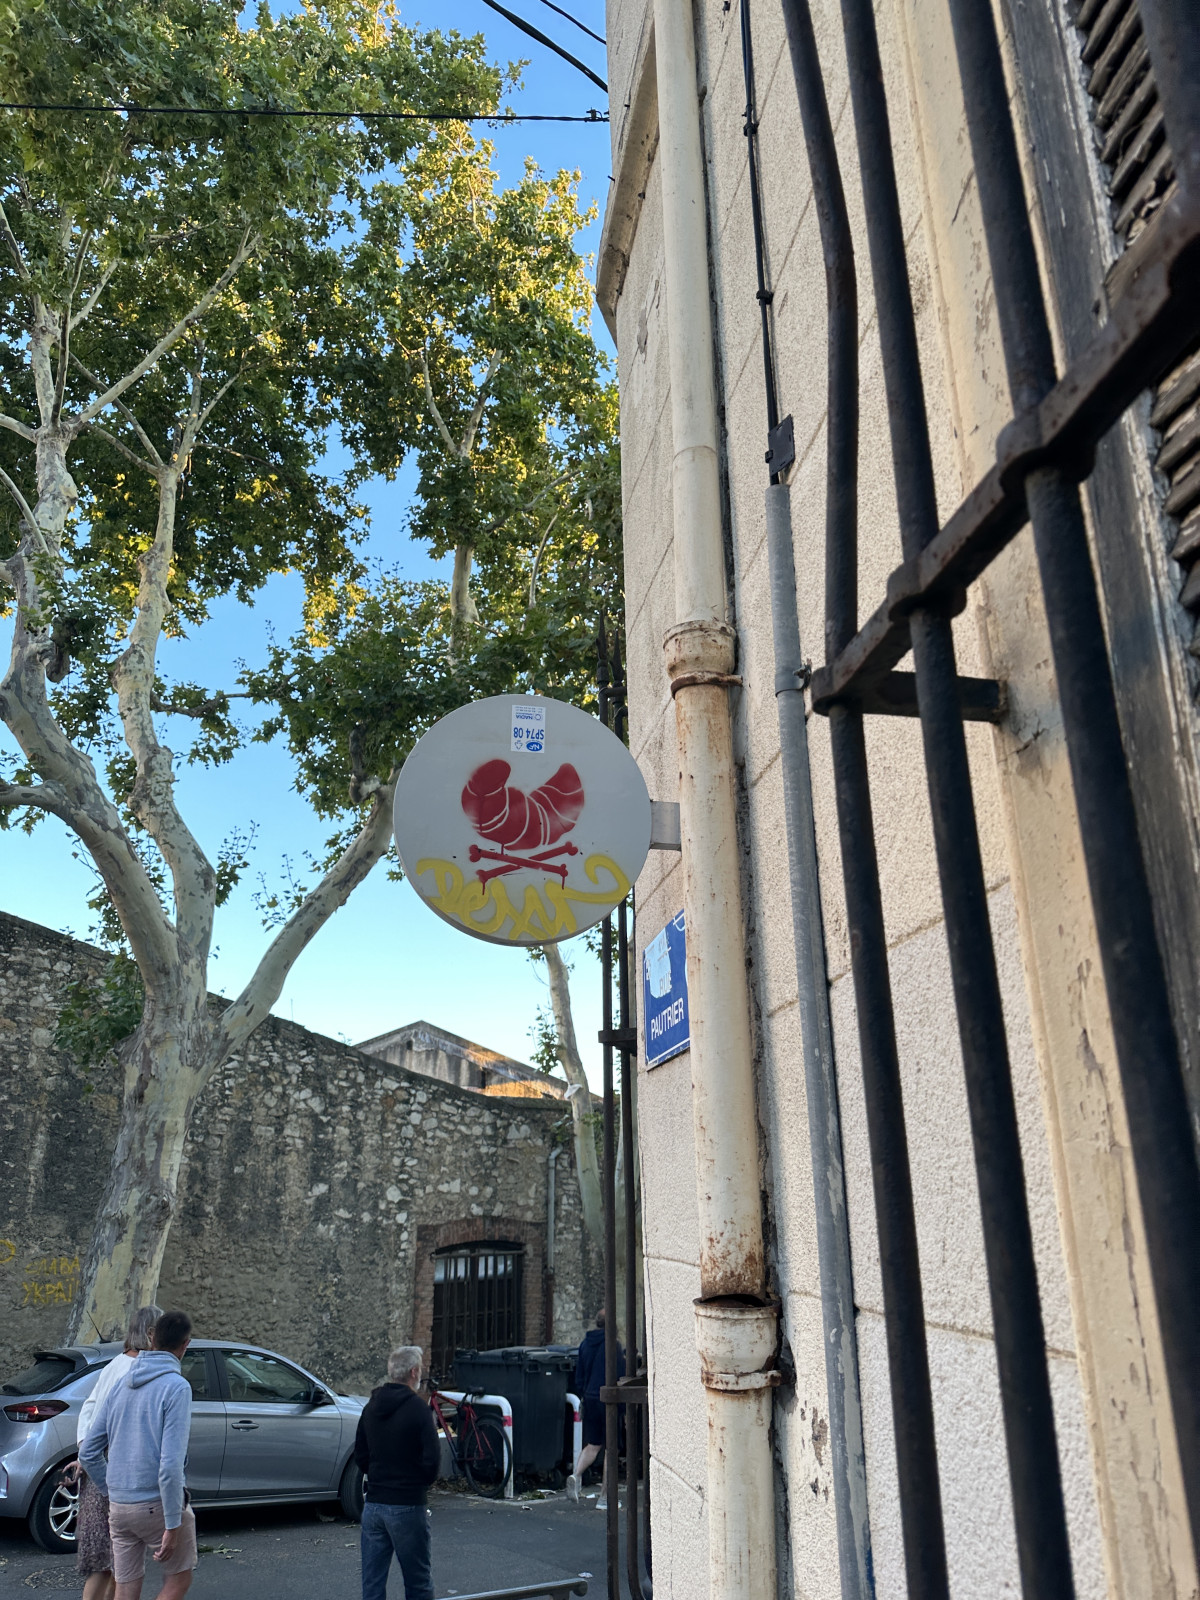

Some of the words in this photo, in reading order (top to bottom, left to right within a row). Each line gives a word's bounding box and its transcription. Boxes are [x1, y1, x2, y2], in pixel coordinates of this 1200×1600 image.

[513, 727, 524, 739] 08
[526, 728, 544, 740] SP74
[651, 998, 684, 1040] PAUTRIER
